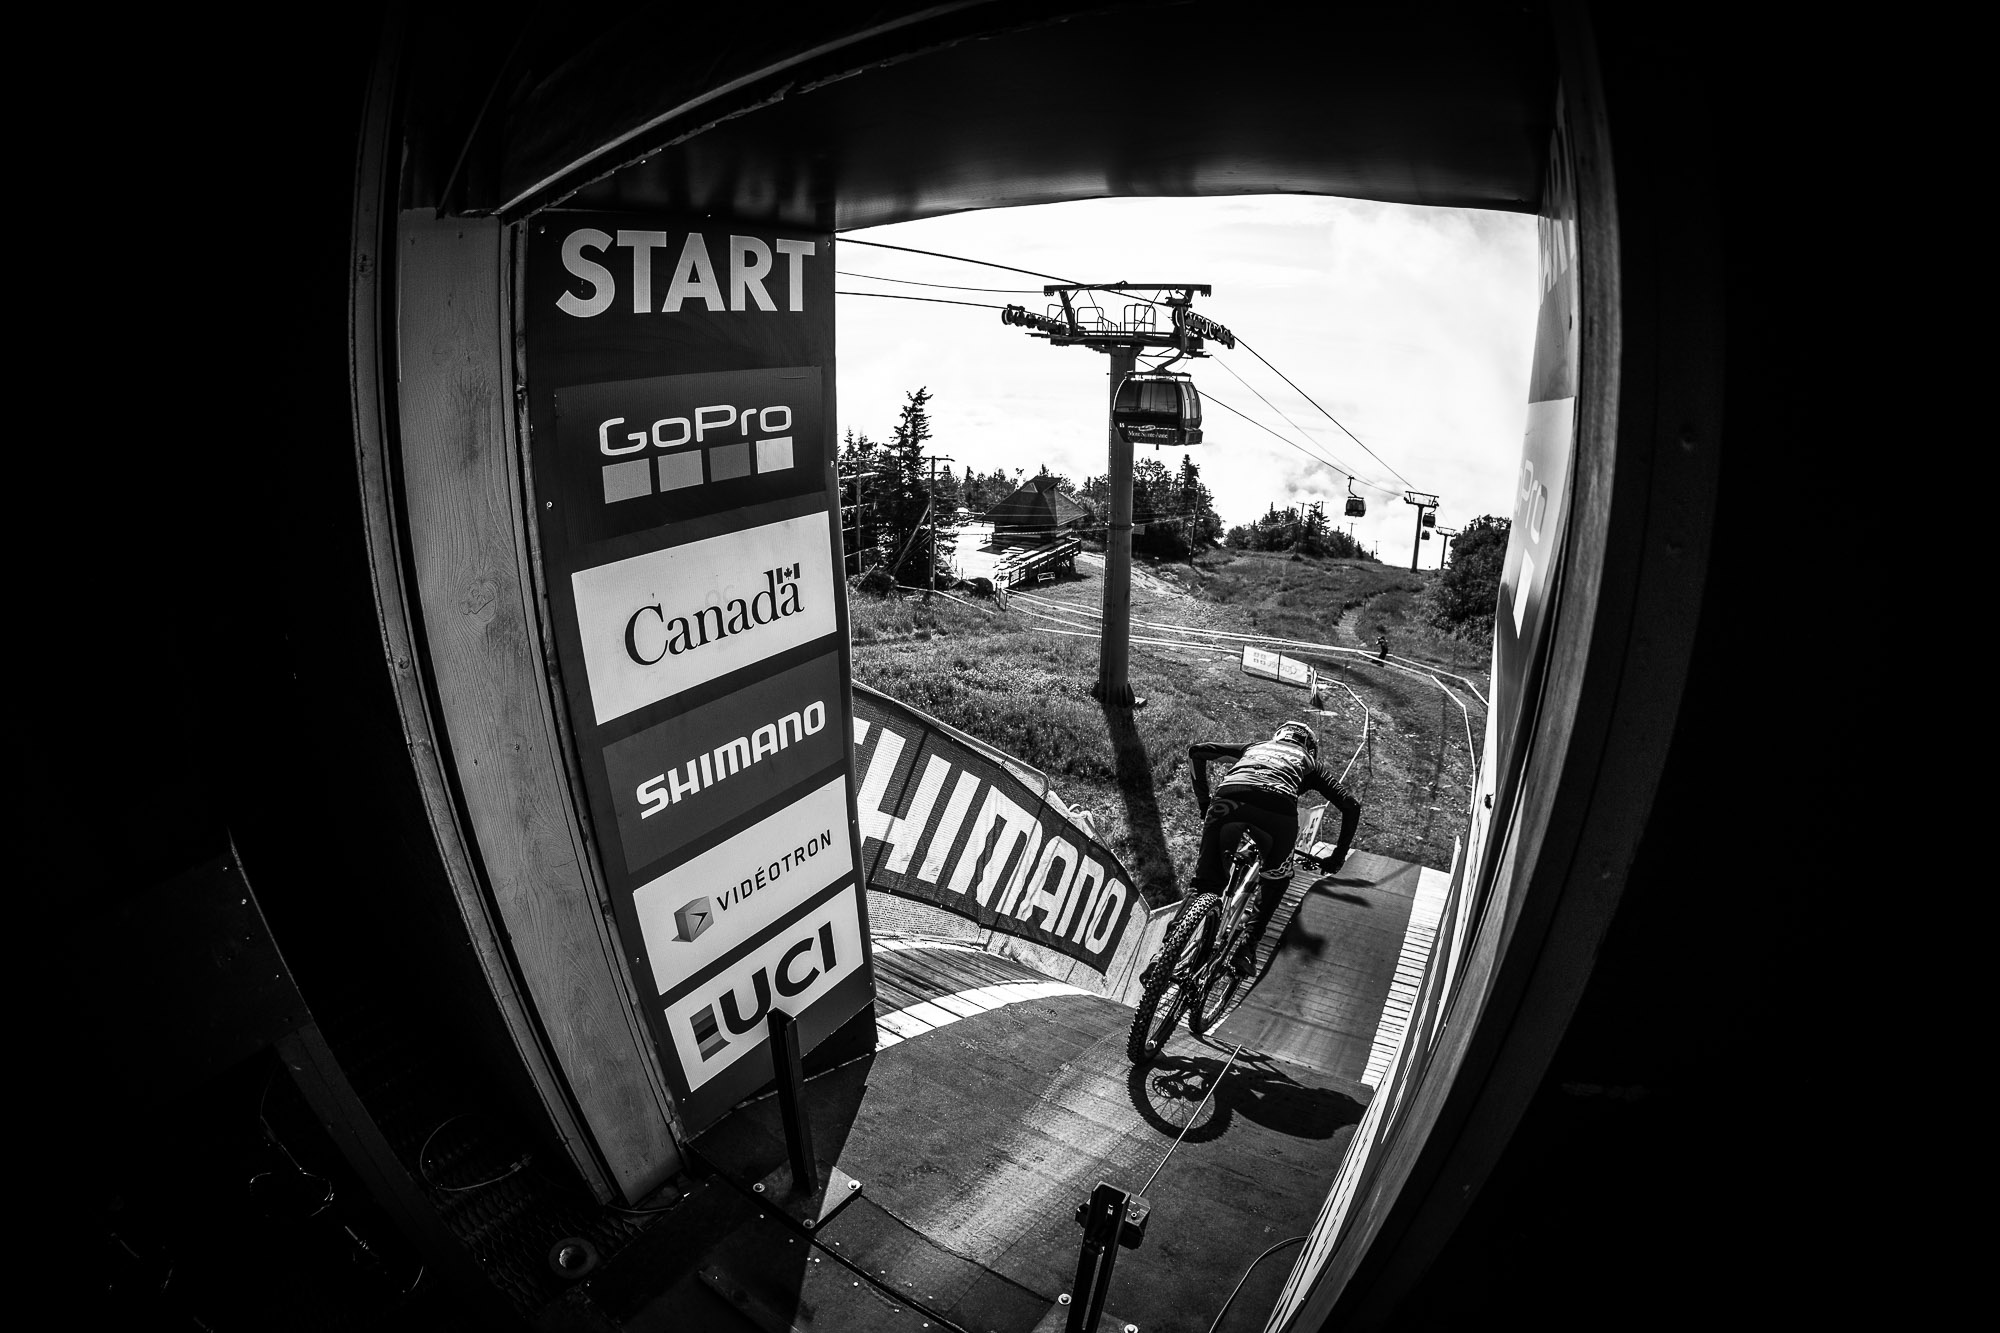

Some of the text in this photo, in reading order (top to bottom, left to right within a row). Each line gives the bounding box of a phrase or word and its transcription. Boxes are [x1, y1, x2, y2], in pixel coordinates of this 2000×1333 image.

[555, 227, 815, 318] START
[599, 404, 793, 456] GoPro
[624, 562, 805, 666] Canada
[636, 700, 826, 820] SHIMANO
[716, 829, 832, 912] VIDÉOTRON
[853, 716, 1127, 955] HIMANO
[718, 920, 837, 1036] UCI
